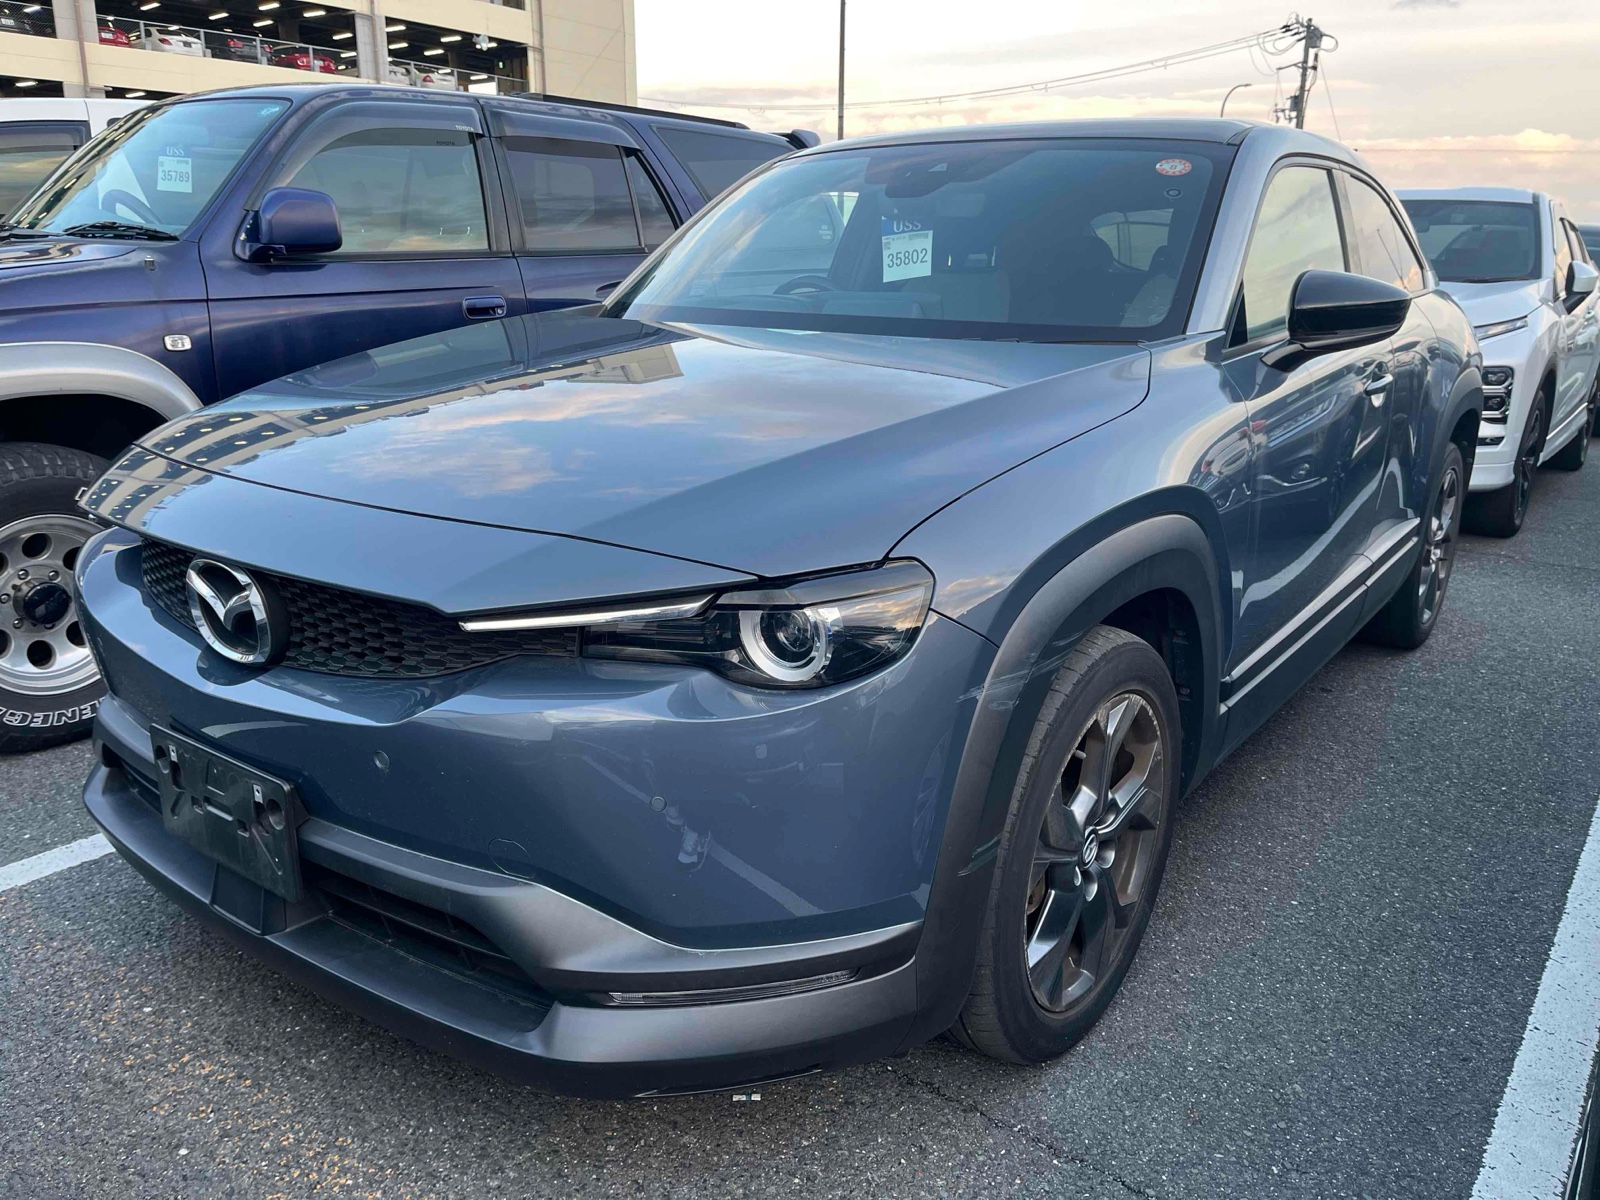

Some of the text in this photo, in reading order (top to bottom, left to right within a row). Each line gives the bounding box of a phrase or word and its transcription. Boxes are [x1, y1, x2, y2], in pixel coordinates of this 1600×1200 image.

[455, 124, 475, 132] TOYOTA
[166, 146, 185, 157] USS
[161, 169, 190, 183] 35789
[893, 219, 922, 233] USS
[887, 248, 928, 269] 35802
[0, 697, 105, 728] ENEG
